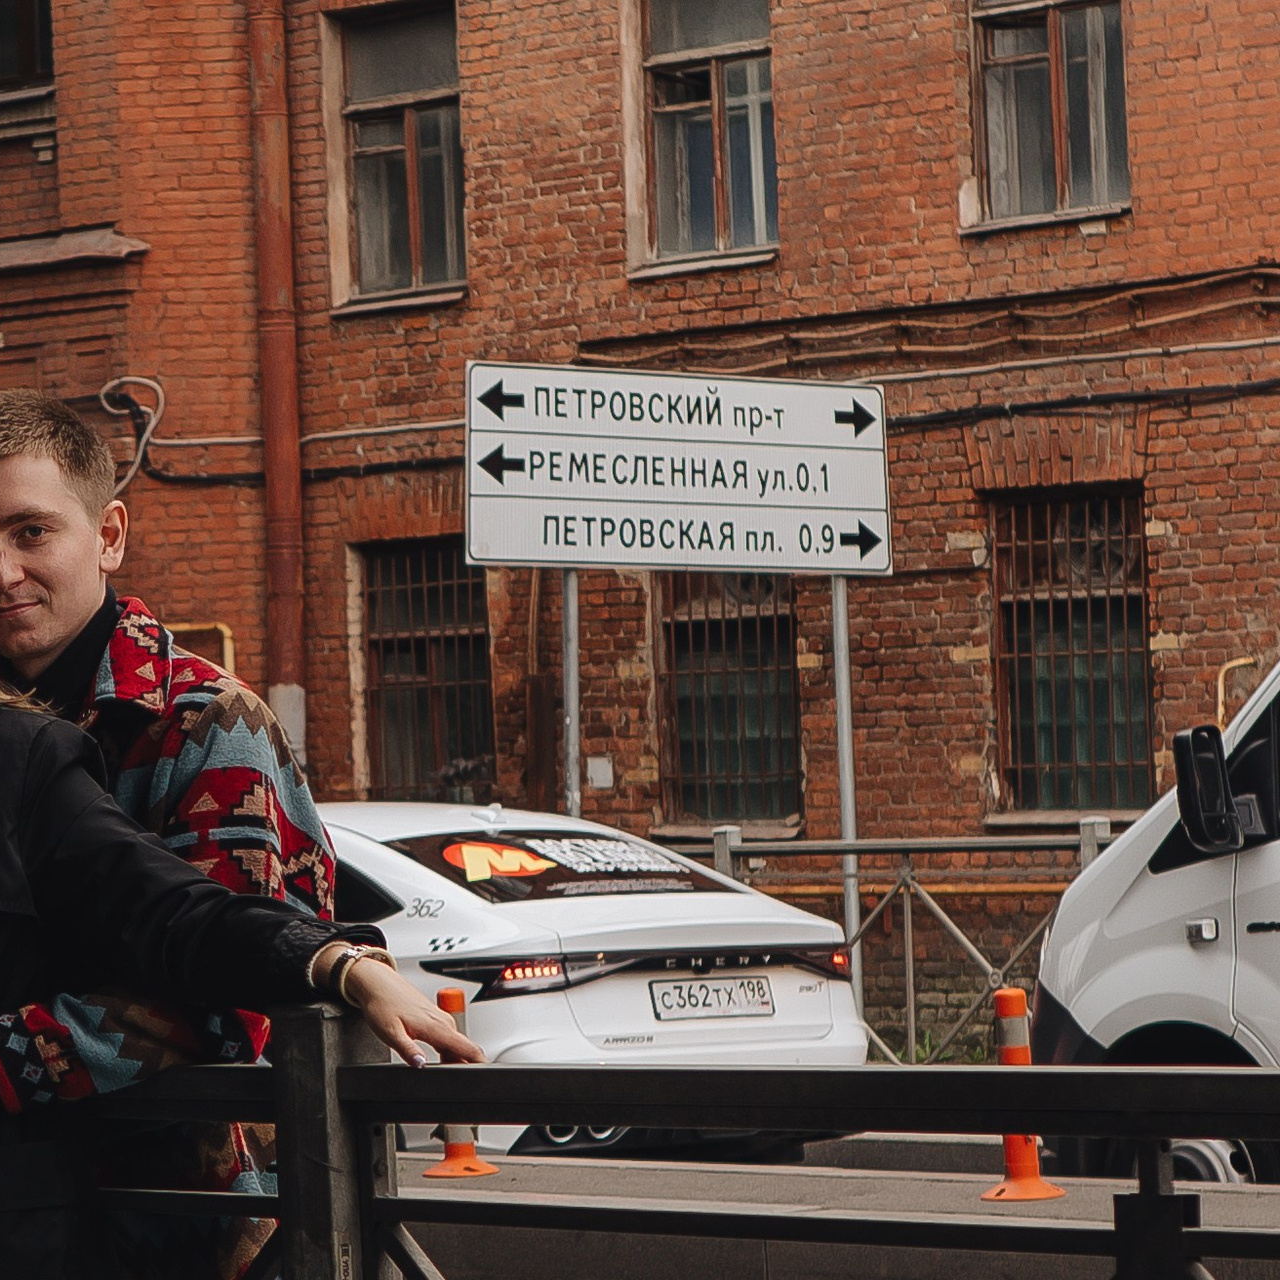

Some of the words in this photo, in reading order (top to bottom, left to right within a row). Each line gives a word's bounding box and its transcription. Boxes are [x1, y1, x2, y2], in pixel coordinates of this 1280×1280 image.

[534, 386, 722, 426] ПЕТРОВСКИЙ
[733, 406, 785, 436] пр-т
[529, 450, 748, 489] РЕМЕСЛЕННАЯ
[543, 515, 735, 551] ПЕТРОВСКАЯ
[745, 530, 783, 553] пл.
[799, 523, 835, 557] 0,9
[406, 897, 445, 918] 362
